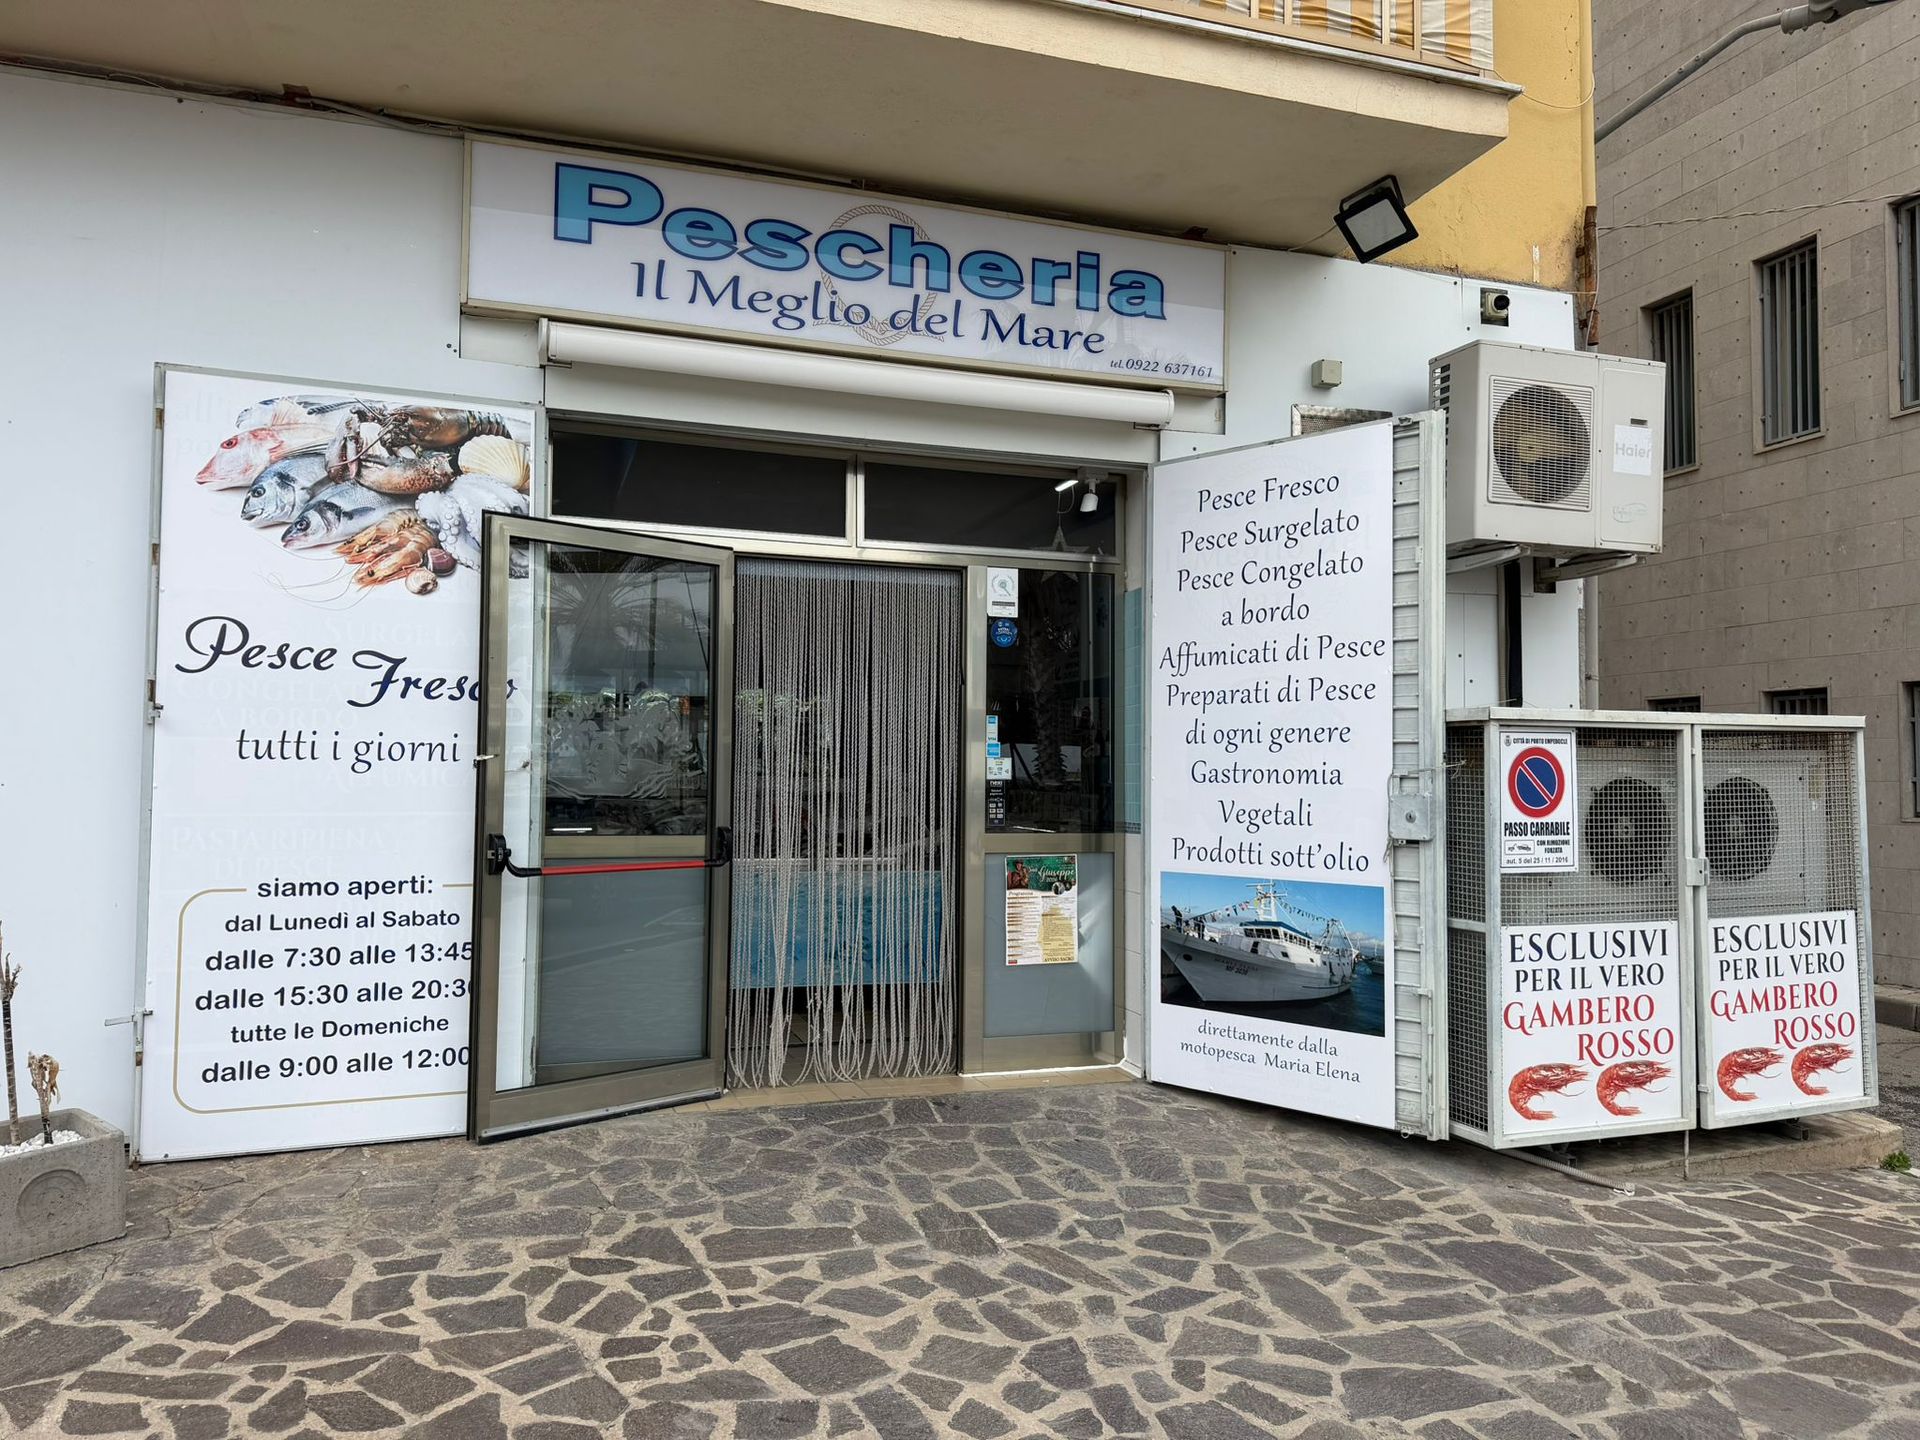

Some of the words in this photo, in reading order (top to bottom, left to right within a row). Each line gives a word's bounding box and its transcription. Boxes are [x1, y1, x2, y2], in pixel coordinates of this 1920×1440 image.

[554, 162, 1167, 319] Pescheria
[631, 259, 669, 301] Il
[687, 268, 871, 330] Meglio
[889, 293, 965, 338] del
[980, 307, 1105, 354] Mare
[1164, 362, 1213, 378] 637161
[1615, 442, 1652, 459] Haier
[1198, 489, 1256, 512] Pesce
[1264, 476, 1340, 502] Fresco
[1181, 530, 1238, 553] Pesce
[1244, 507, 1360, 549] Surgelato
[1177, 568, 1234, 592] Pesce
[1241, 548, 1363, 590] Congelato
[1221, 610, 1234, 627] a
[1240, 593, 1310, 625] bordo
[175, 616, 338, 673] Pesce
[1159, 639, 1280, 677] Affumicati
[1286, 633, 1309, 662] di
[1317, 635, 1385, 659] Pesce
[1166, 680, 1271, 714] Preparati
[1277, 675, 1301, 703] di
[1308, 677, 1376, 702] Pesce
[236, 728, 319, 761] tutti
[332, 730, 341, 761] i
[351, 732, 461, 774] giorni
[1186, 718, 1207, 744] di
[1213, 721, 1262, 753] ogni
[1268, 725, 1351, 753] genere
[1191, 760, 1343, 785] Gastronomia
[1218, 798, 1313, 834] Vegetali
[1504, 822, 1528, 837] PASSO
[1530, 821, 1570, 837] CARRABILE
[1172, 836, 1263, 865] Prodotti
[1271, 841, 1369, 872] sott'olio
[258, 877, 339, 897] siamo
[348, 875, 433, 900] aperti:
[225, 914, 261, 932] dal
[269, 912, 349, 931] Lunedì
[356, 911, 375, 928] al
[382, 909, 460, 927] Sabato
[1712, 919, 1847, 953] ESCLUSIVI
[205, 949, 274, 971] dalle
[284, 946, 341, 968] 7:30
[349, 945, 396, 965] alle
[405, 942, 472, 963] 13:45
[1509, 928, 1668, 963] ESCLUSIVI
[1515, 967, 1563, 993] PER
[1570, 966, 1592, 990] IL
[1599, 962, 1664, 988] VERO
[1719, 957, 1759, 981] PER
[1765, 956, 1784, 978] IL
[1789, 951, 1845, 976] VERO
[195, 988, 264, 1011] dalle
[274, 984, 348, 1007] 15:30
[357, 982, 403, 1003] alle
[411, 978, 471, 1000] 20:3
[1710, 981, 1837, 1022] GAMBERO
[230, 1024, 287, 1043] tutte
[294, 1022, 314, 1040] le
[322, 1015, 449, 1038] Domeniche
[1503, 994, 1655, 1036] GAMBERO
[1774, 1011, 1855, 1050] ROSSO
[1197, 1019, 1294, 1049] direttamente
[1298, 1035, 1338, 1057] dalla
[1577, 1027, 1674, 1067] ROSSO
[201, 1060, 270, 1083] dalle
[279, 1055, 338, 1078] 9:00
[346, 1052, 393, 1073] alle
[402, 1046, 469, 1069] 12:00
[1181, 1041, 1256, 1064] motopesca
[1264, 1052, 1311, 1074] Maria
[1316, 1061, 1360, 1083] Elena
